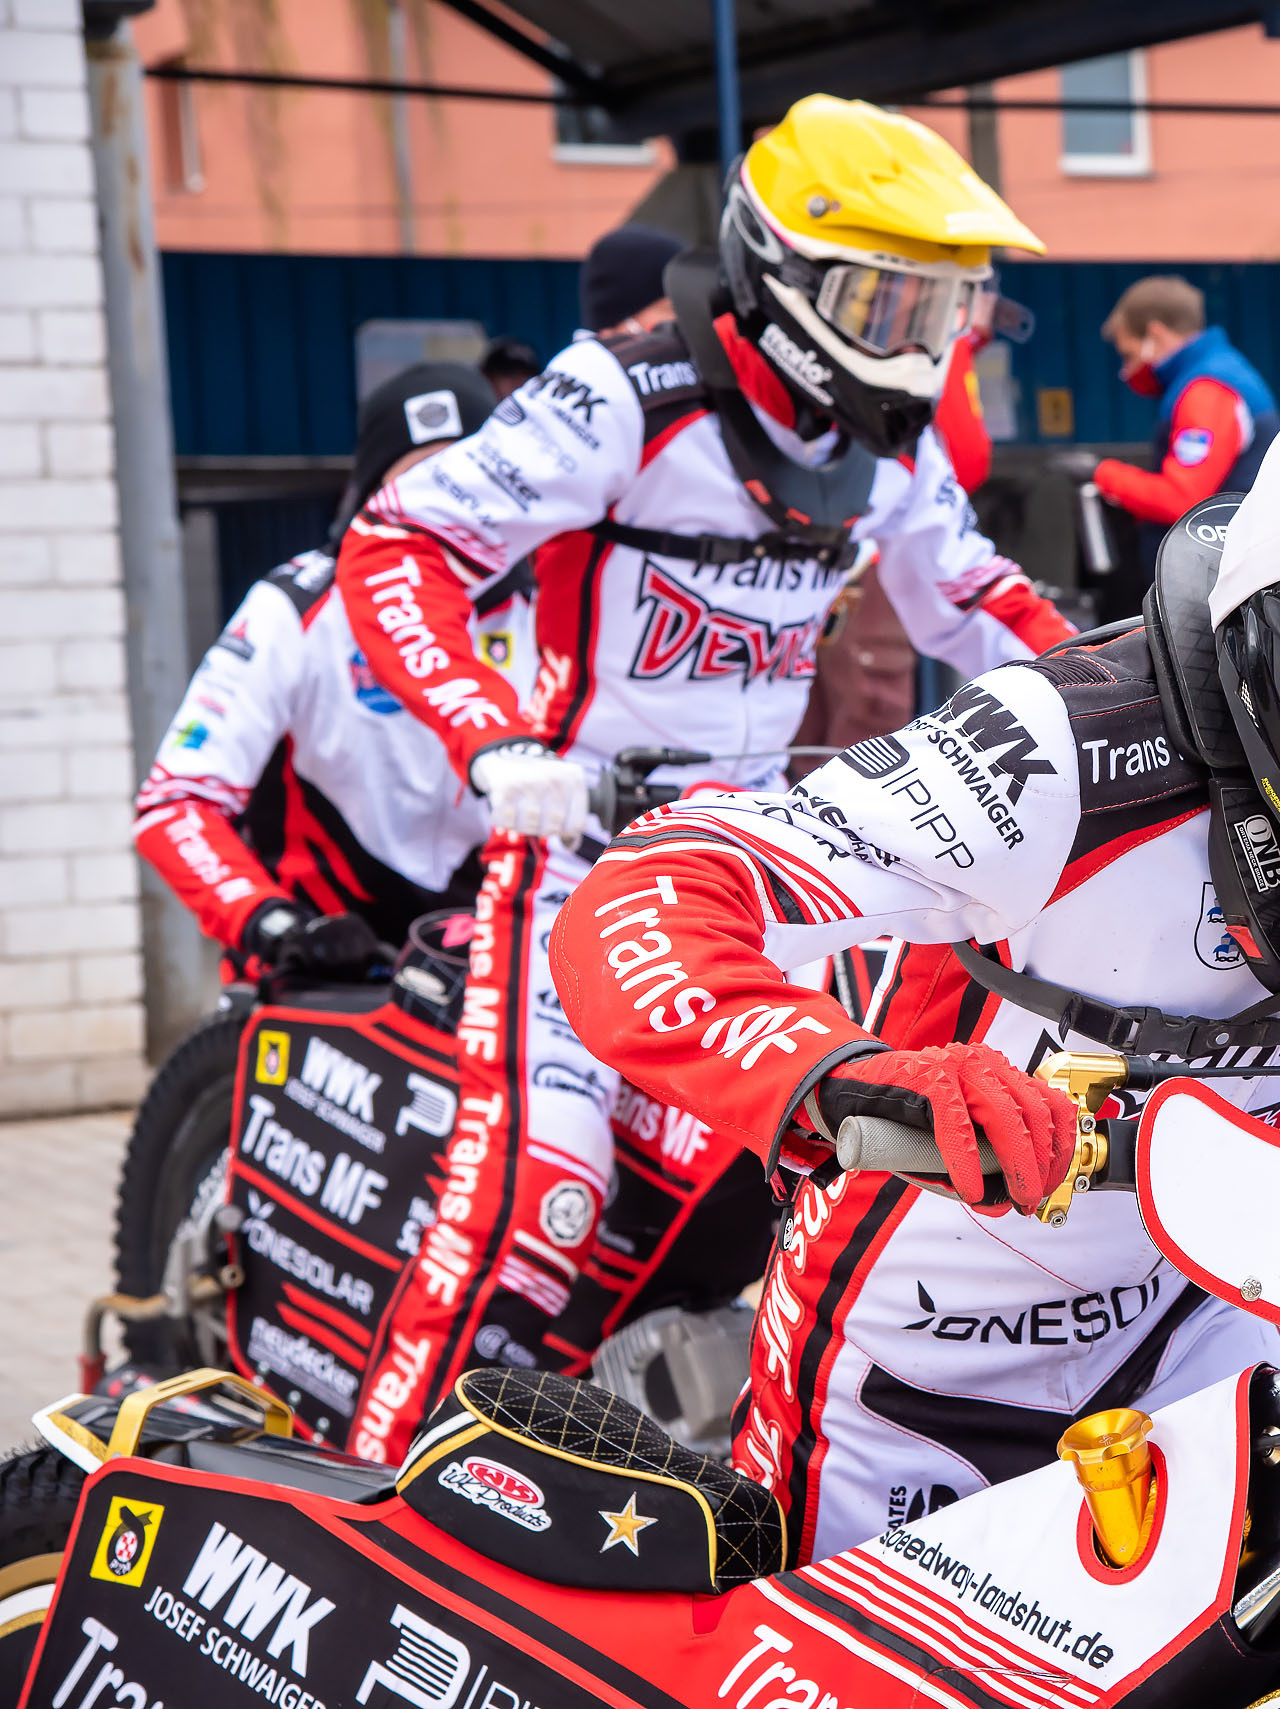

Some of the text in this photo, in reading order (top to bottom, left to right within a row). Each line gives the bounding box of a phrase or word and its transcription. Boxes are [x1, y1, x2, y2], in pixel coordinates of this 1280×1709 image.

[628, 361, 699, 396] Trans
[364, 555, 509, 730] Trans MF
[927, 729, 1026, 850] SCHWAIGER
[929, 684, 1059, 807] WWK
[1082, 736, 1171, 784] Trans
[594, 875, 717, 1033] Trans
[301, 1036, 383, 1124] WWK
[457, 985, 501, 1062] MF
[241, 1094, 389, 1225] Trans MF
[438, 1092, 504, 1222] Trans
[354, 1331, 432, 1464] Trans
[476, 1484, 547, 1527] Products
[144, 1585, 206, 1643] JOSEF
[182, 1521, 337, 1679] WWK
[879, 1529, 1115, 1671] speedway-landshut.de
